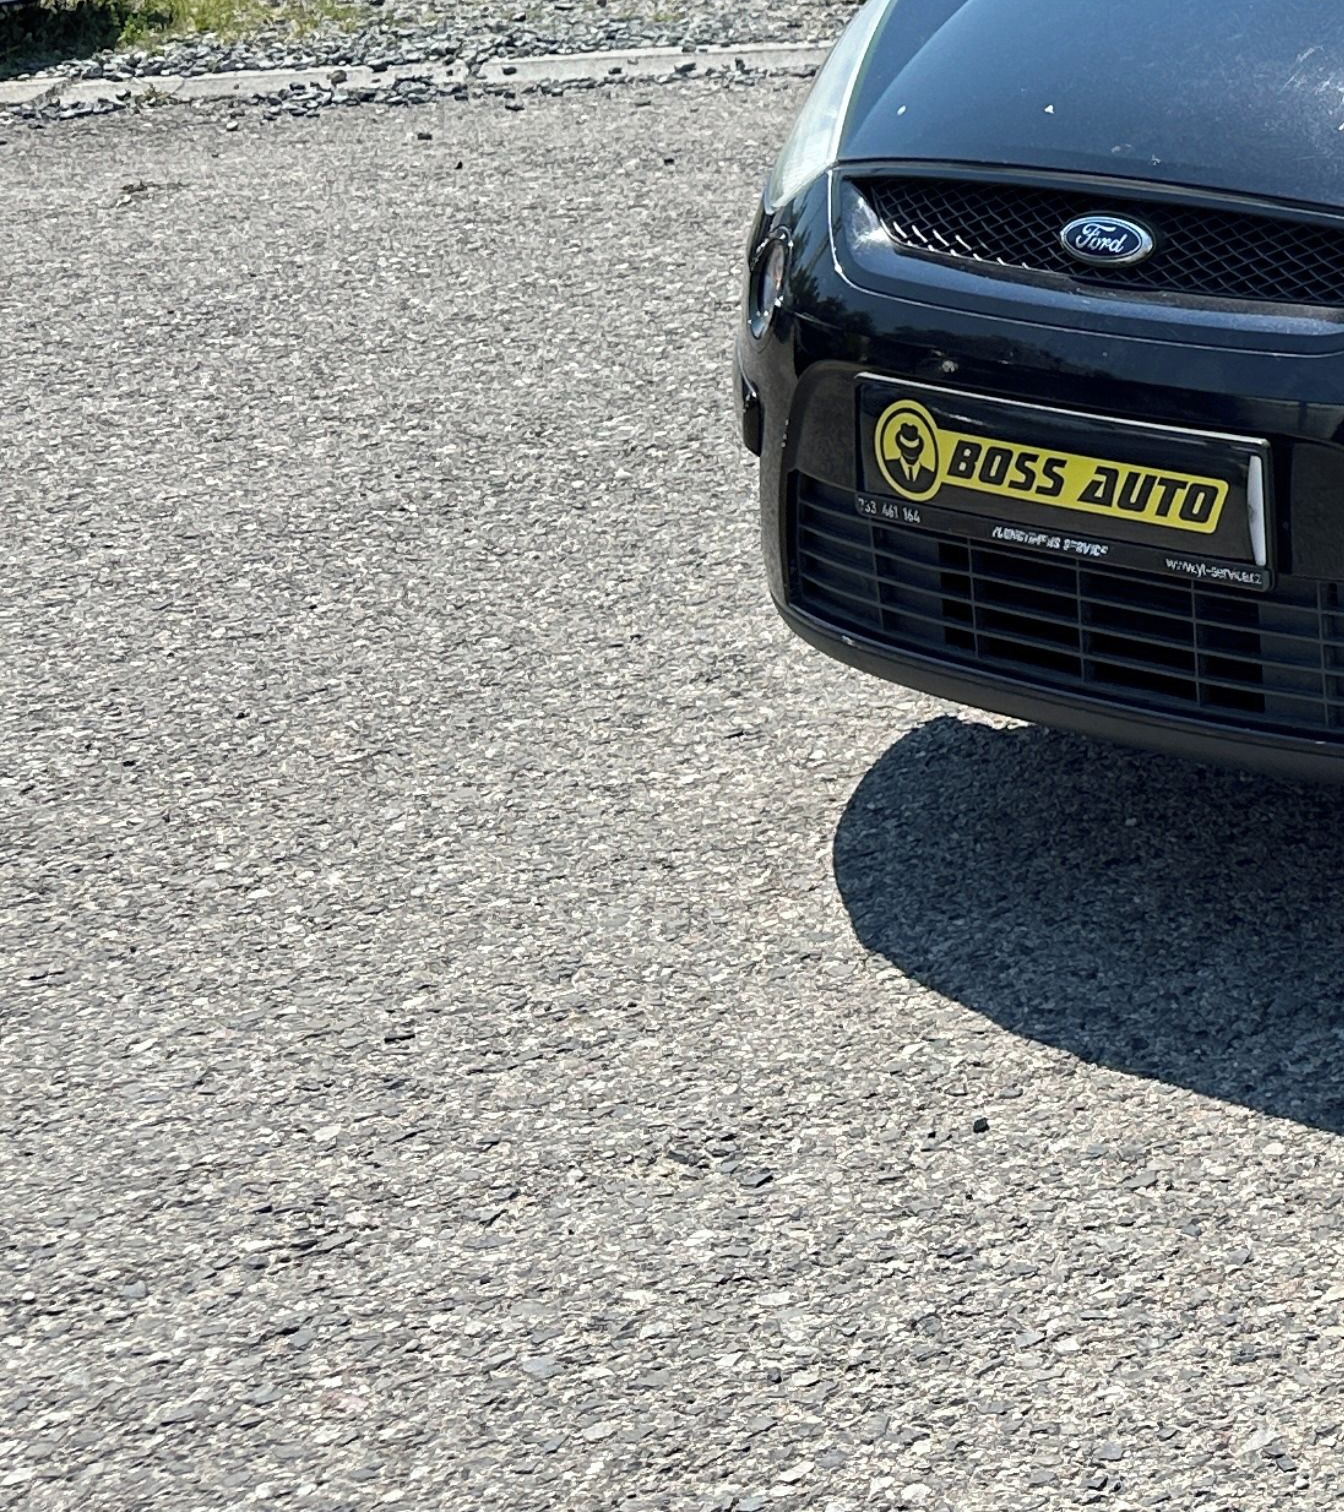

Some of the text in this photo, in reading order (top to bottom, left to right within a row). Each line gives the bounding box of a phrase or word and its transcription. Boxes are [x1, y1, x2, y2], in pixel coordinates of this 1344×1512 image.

[1076, 222, 1129, 253] Ford
[946, 439, 1220, 524] BOSS AUTO
